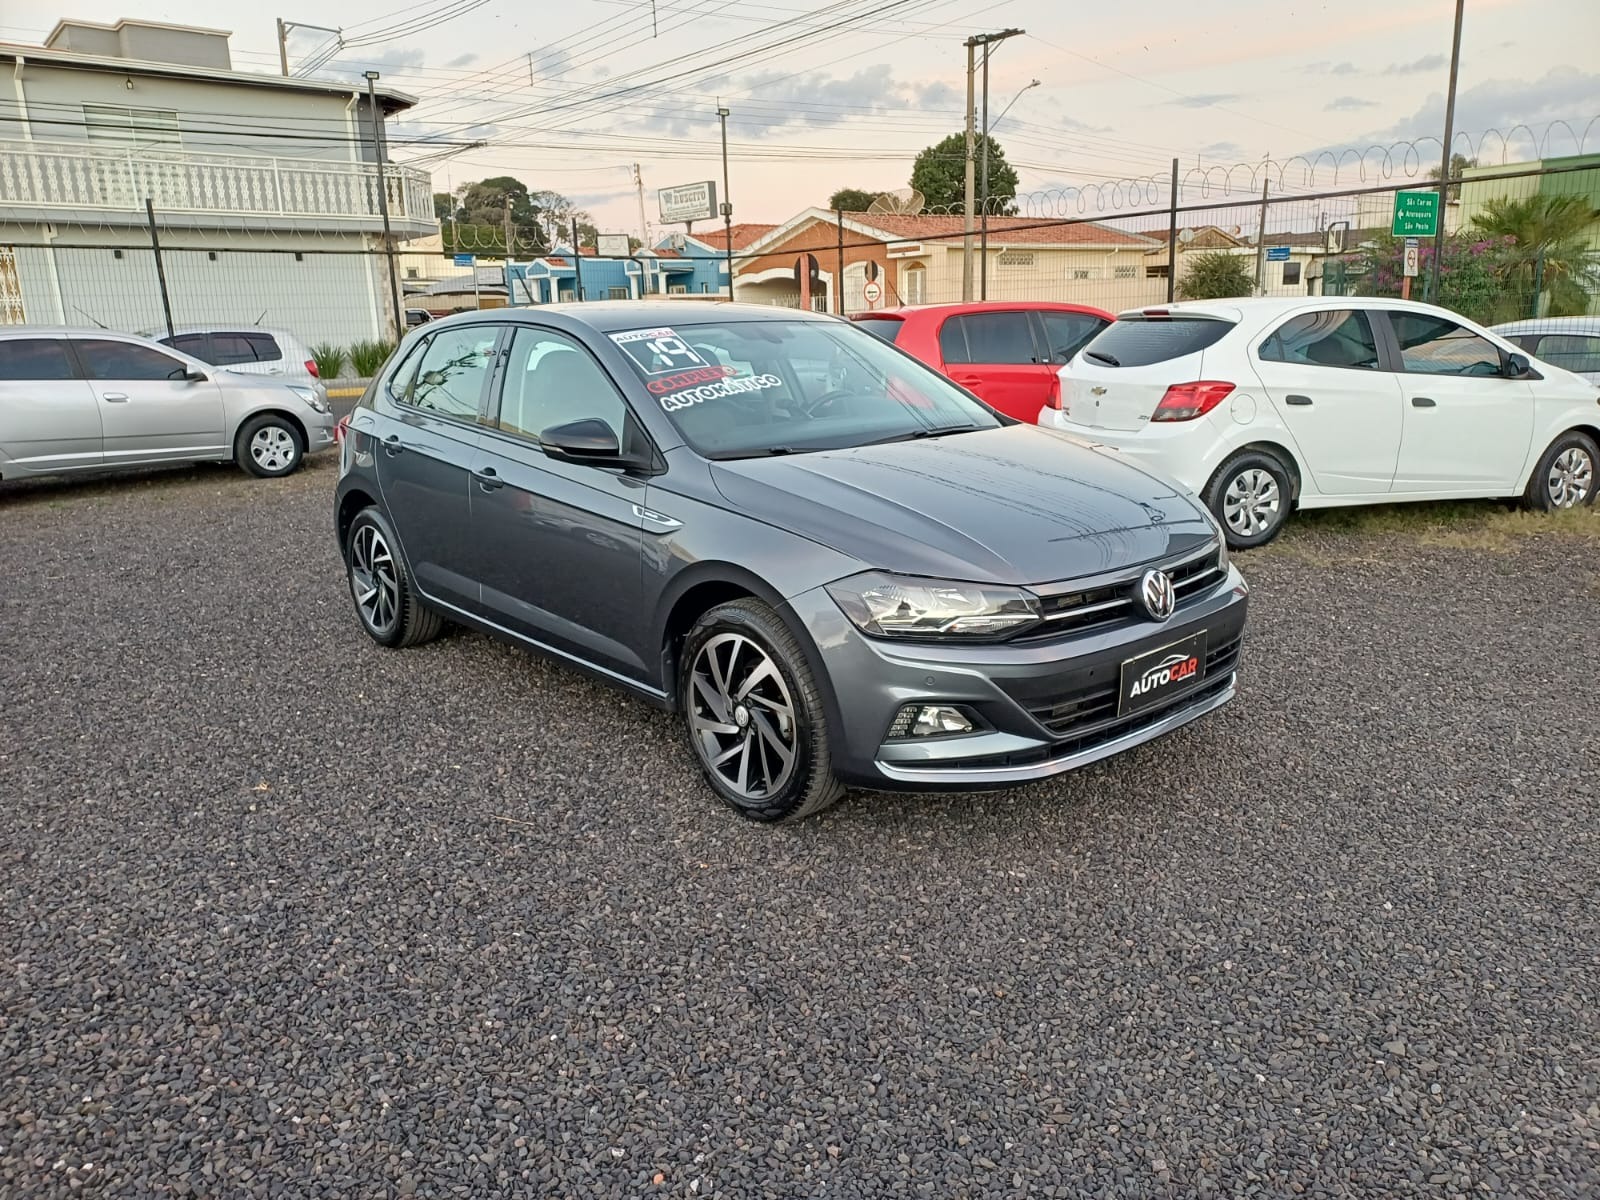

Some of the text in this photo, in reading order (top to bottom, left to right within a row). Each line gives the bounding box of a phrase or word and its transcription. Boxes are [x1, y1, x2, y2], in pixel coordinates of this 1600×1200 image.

[1417, 198, 1432, 206] Caros
[616, 330, 675, 342] AUTOCAR
[646, 337, 700, 367] 19
[660, 374, 781, 411] AUTOMÁTICO
[1130, 658, 1198, 698] AUTOCAR
